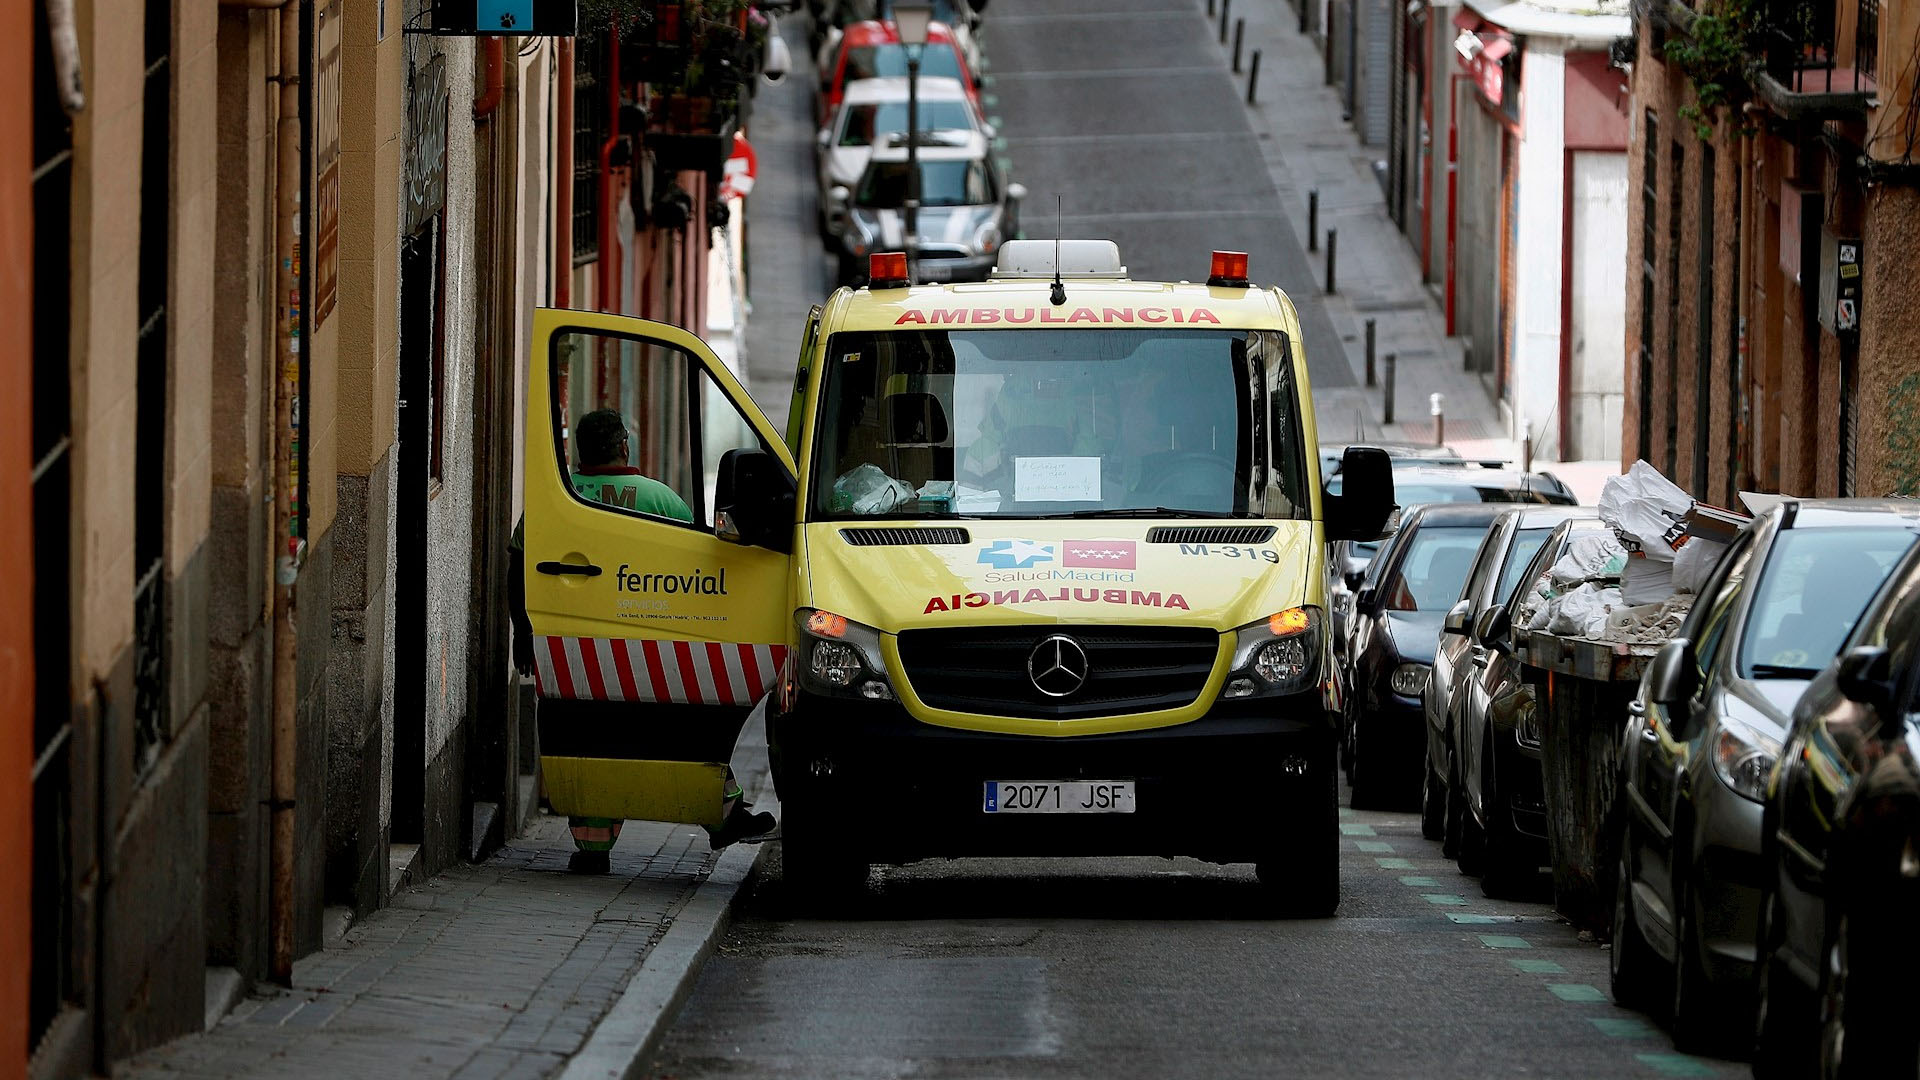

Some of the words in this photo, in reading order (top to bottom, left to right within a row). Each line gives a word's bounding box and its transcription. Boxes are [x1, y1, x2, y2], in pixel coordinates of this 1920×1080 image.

[894, 307, 1221, 325] AMBULANCIA
[1179, 544, 1280, 564] M-319
[616, 564, 728, 595] ferrovial
[984, 570, 1135, 583] SaludMadrid
[988, 799, 995, 807] E
[1003, 785, 1061, 809] 2071
[1081, 785, 1125, 809] JSF
